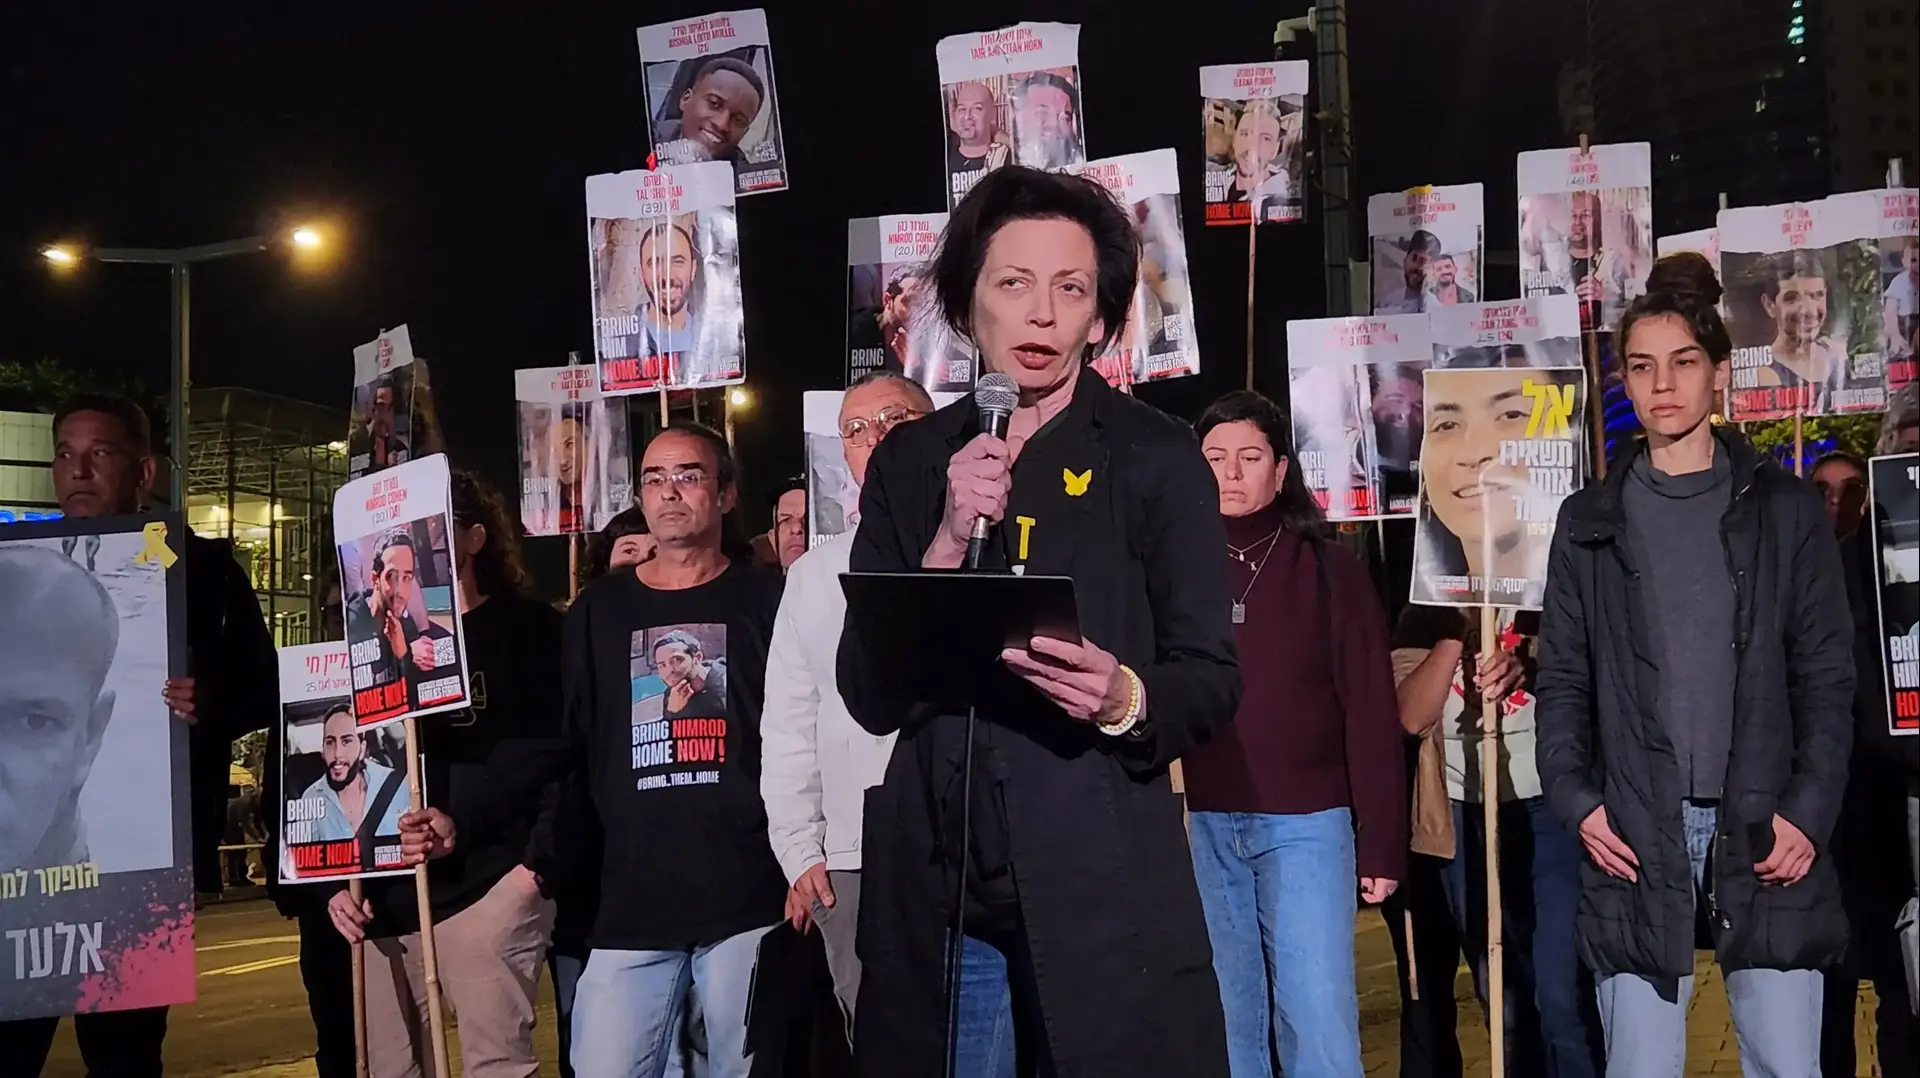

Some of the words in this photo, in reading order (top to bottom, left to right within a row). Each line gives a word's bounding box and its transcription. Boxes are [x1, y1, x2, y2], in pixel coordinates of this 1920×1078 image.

[1023, 38, 1043, 52] HORN
[636, 189, 649, 201] TAL
[651, 185, 684, 199] SHOAM
[641, 202, 663, 216] (39)
[888, 232, 914, 244] NIMROD
[914, 232, 938, 243] COHEN
[894, 245, 915, 258] (20)
[601, 314, 639, 337] BRING
[602, 336, 628, 359] HIM
[851, 348, 884, 368] BRING
[1730, 345, 1774, 369] BRING
[603, 357, 641, 381] HOME
[1732, 367, 1759, 389] HIM
[1521, 378, 1576, 440] אל
[1732, 389, 1772, 412] HOME
[1499, 439, 1573, 468] תשאירו
[1528, 467, 1575, 495] אותו
[387, 487, 408, 505] COHEN
[372, 508, 389, 527] (20)
[350, 637, 381, 667] BRING
[305, 656, 320, 675] חי
[323, 652, 349, 677] דיין
[353, 663, 374, 691] HIM
[356, 686, 385, 715] HOME
[1896, 692, 1919, 717] HO
[632, 720, 670, 746] BRING
[672, 718, 727, 739] NIMROD
[632, 740, 674, 770] HOME
[287, 797, 326, 822] BRING
[287, 821, 313, 845] HIM
[326, 838, 360, 866] NOW!
[0, 868, 28, 899] למ
[34, 861, 99, 897] הופקר
[5, 921, 105, 980] אלעד
